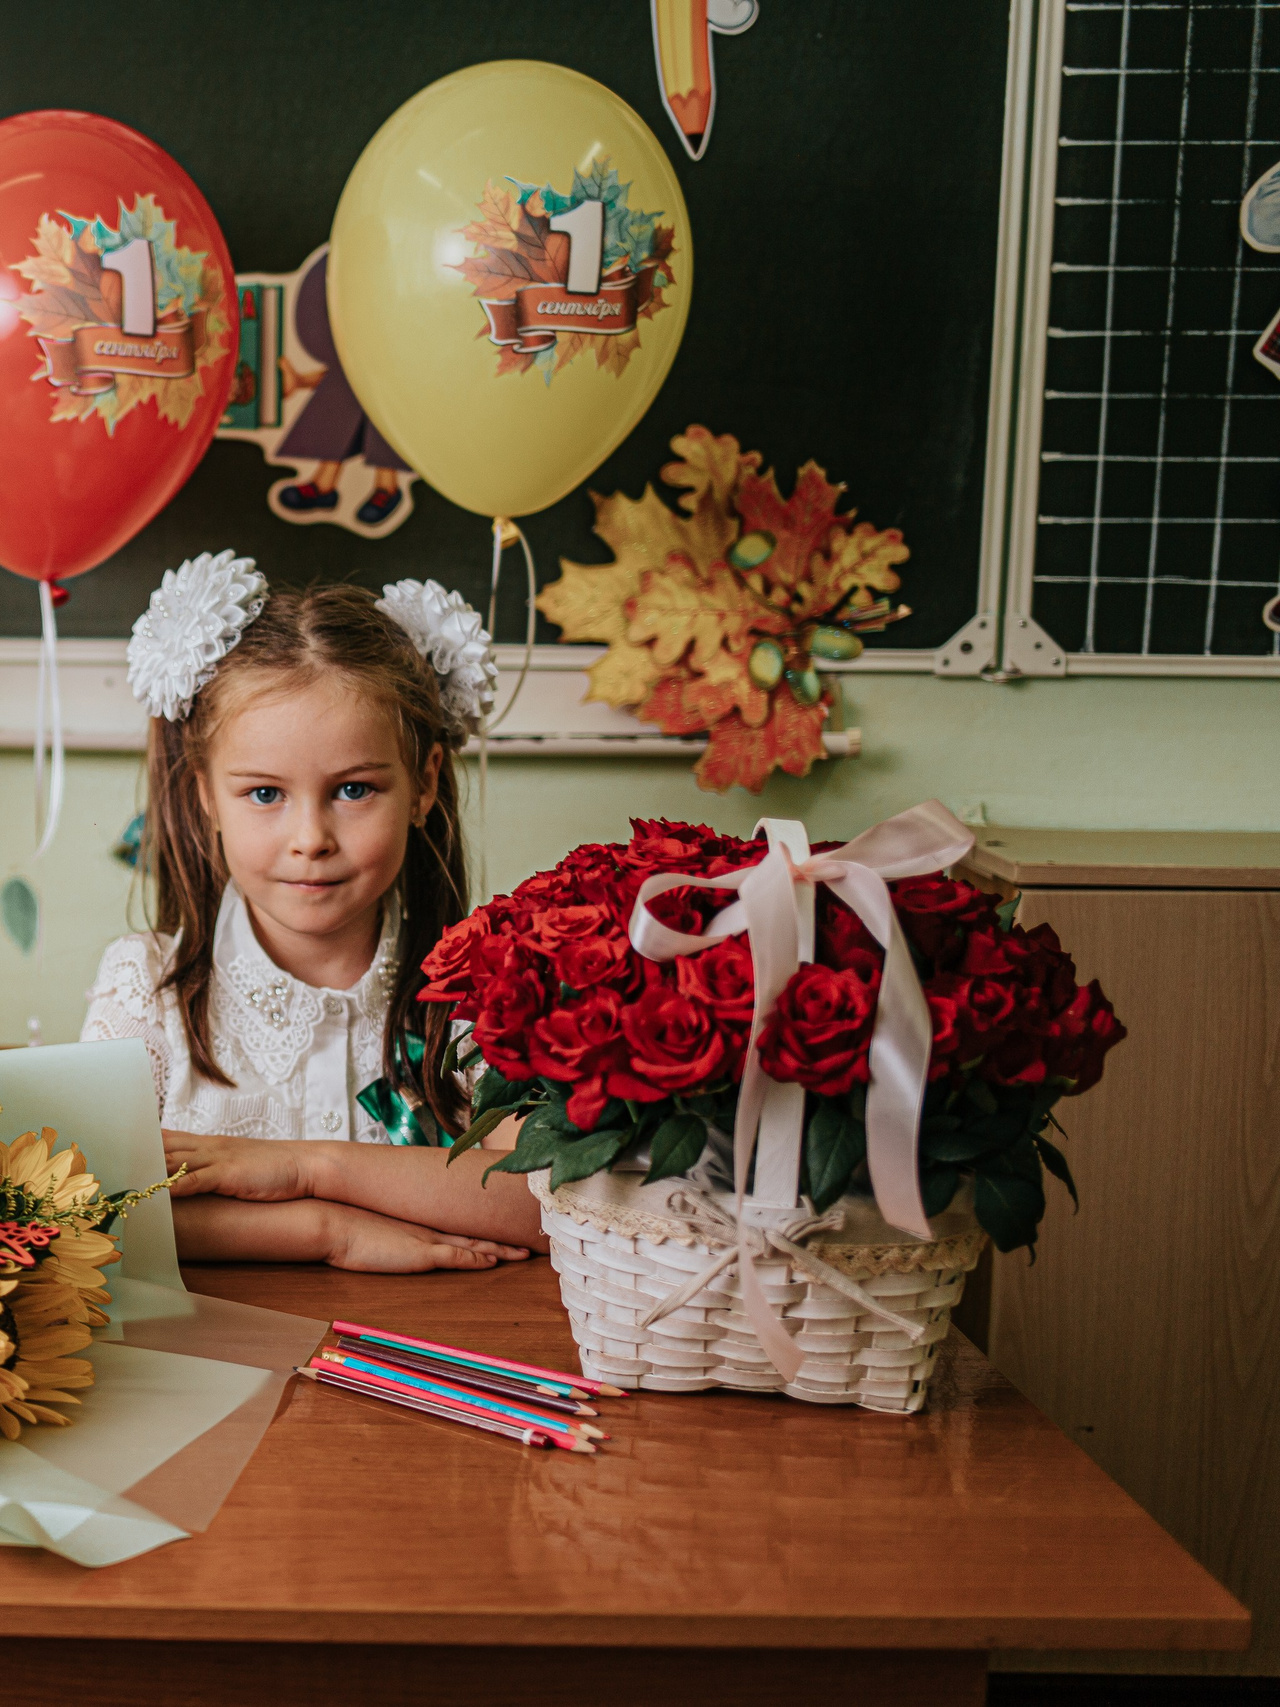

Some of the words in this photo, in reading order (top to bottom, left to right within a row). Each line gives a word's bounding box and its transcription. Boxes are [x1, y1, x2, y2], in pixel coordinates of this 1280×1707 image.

[550, 199, 604, 295] 1
[102, 238, 156, 337] 1
[537, 299, 623, 321] сентября
[94, 340, 179, 364] сентября
